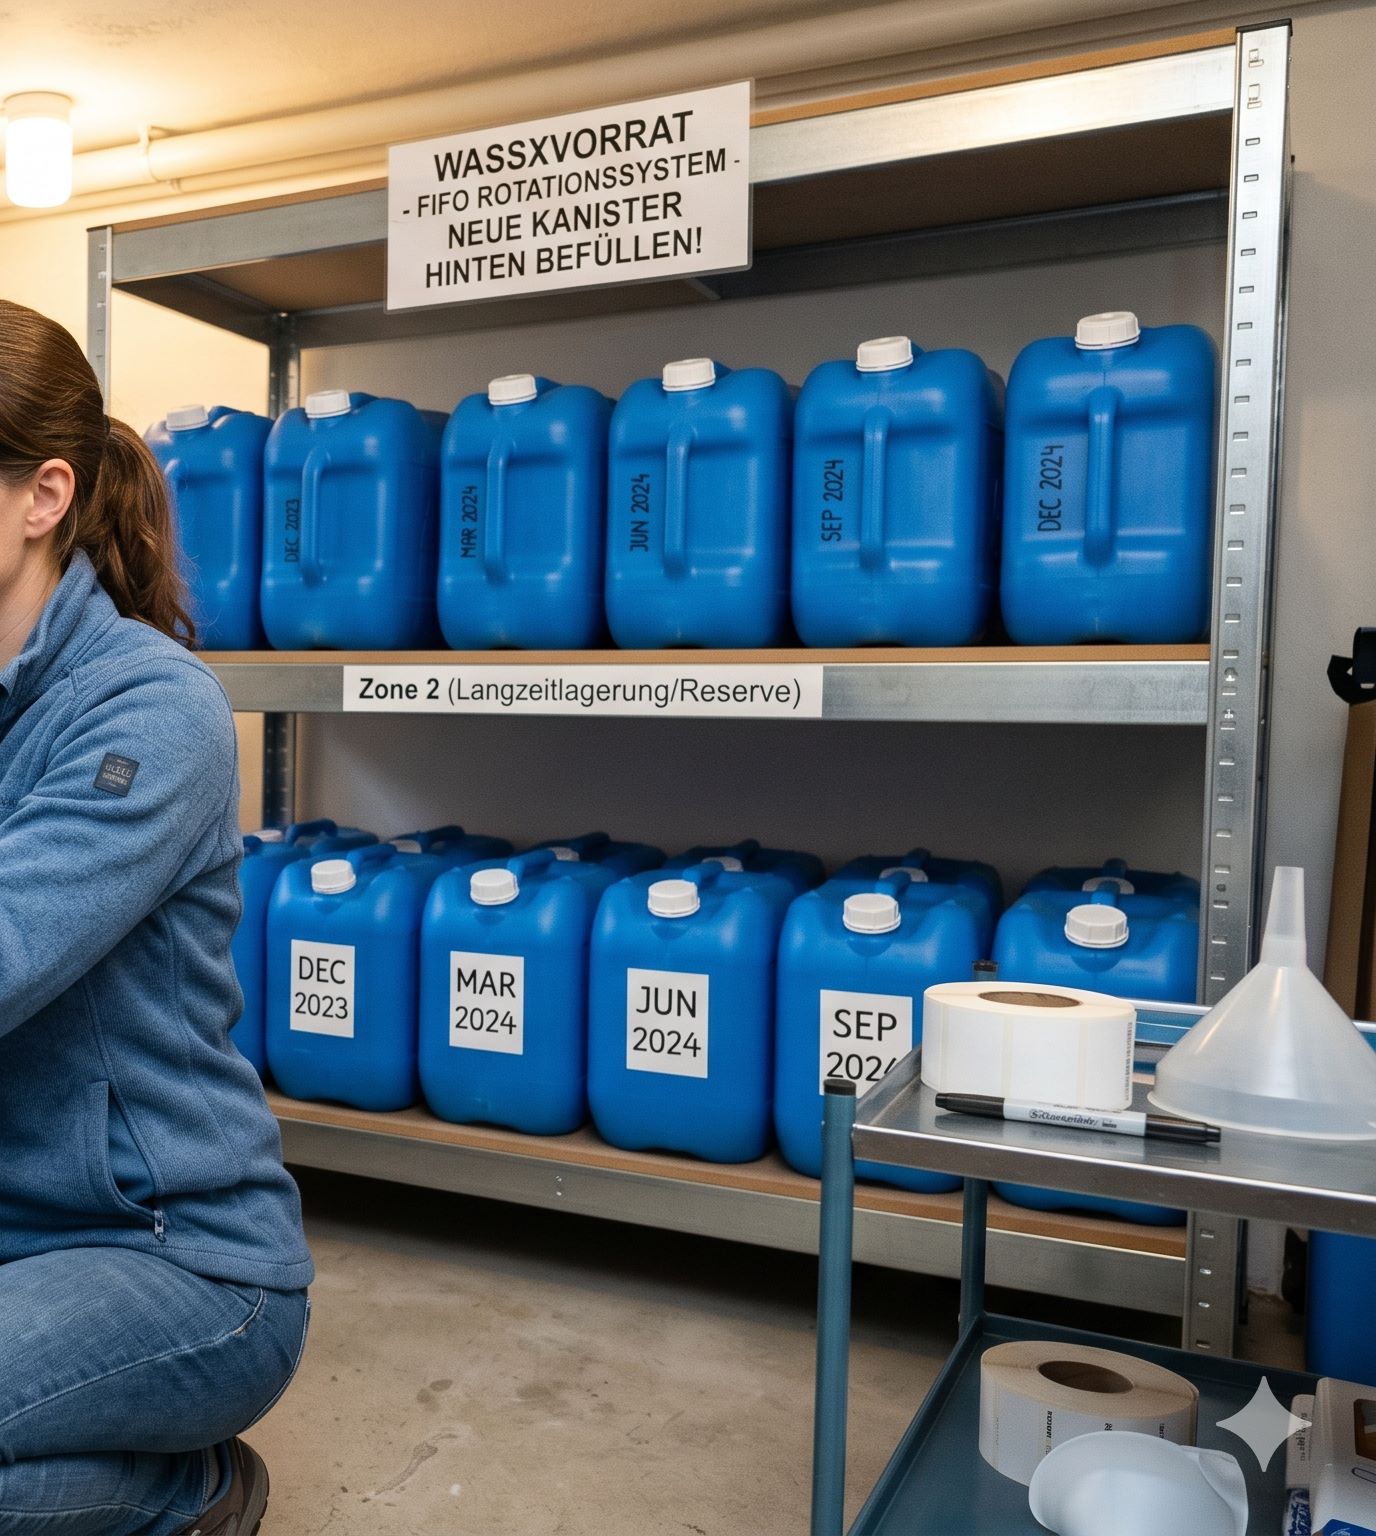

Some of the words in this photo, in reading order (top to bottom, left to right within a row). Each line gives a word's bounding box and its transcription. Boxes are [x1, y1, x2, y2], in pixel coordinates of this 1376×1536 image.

[433, 109, 694, 182] WASSXVORRAT
[417, 189, 470, 218] FIFO
[477, 147, 726, 209] ROTATIONSSYSTEM
[448, 213, 522, 250] NEUE
[532, 191, 683, 238] KANISTER
[425, 250, 526, 289] HINTEN
[536, 226, 703, 275] BEFÜLLEN!
[823, 459, 844, 502] 2024
[1039, 445, 1064, 490] 2024
[461, 485, 478, 523] 2024
[631, 473, 650, 513] 2024
[821, 509, 842, 542] SEP
[1037, 498, 1062, 532] DEC
[460, 528, 477, 559] MAR
[630, 520, 649, 552] JUN
[358, 677, 419, 700] Zone
[426, 677, 440, 700] 2
[448, 677, 801, 710] (Langzeitlagerung/Reserve)
[298, 955, 346, 985] DEC
[456, 967, 517, 999] MAR
[294, 991, 349, 1020] 2023
[635, 985, 697, 1019] JUN
[455, 1005, 517, 1035] 2024
[833, 1008, 897, 1041] SEP
[632, 1026, 702, 1058] 2024
